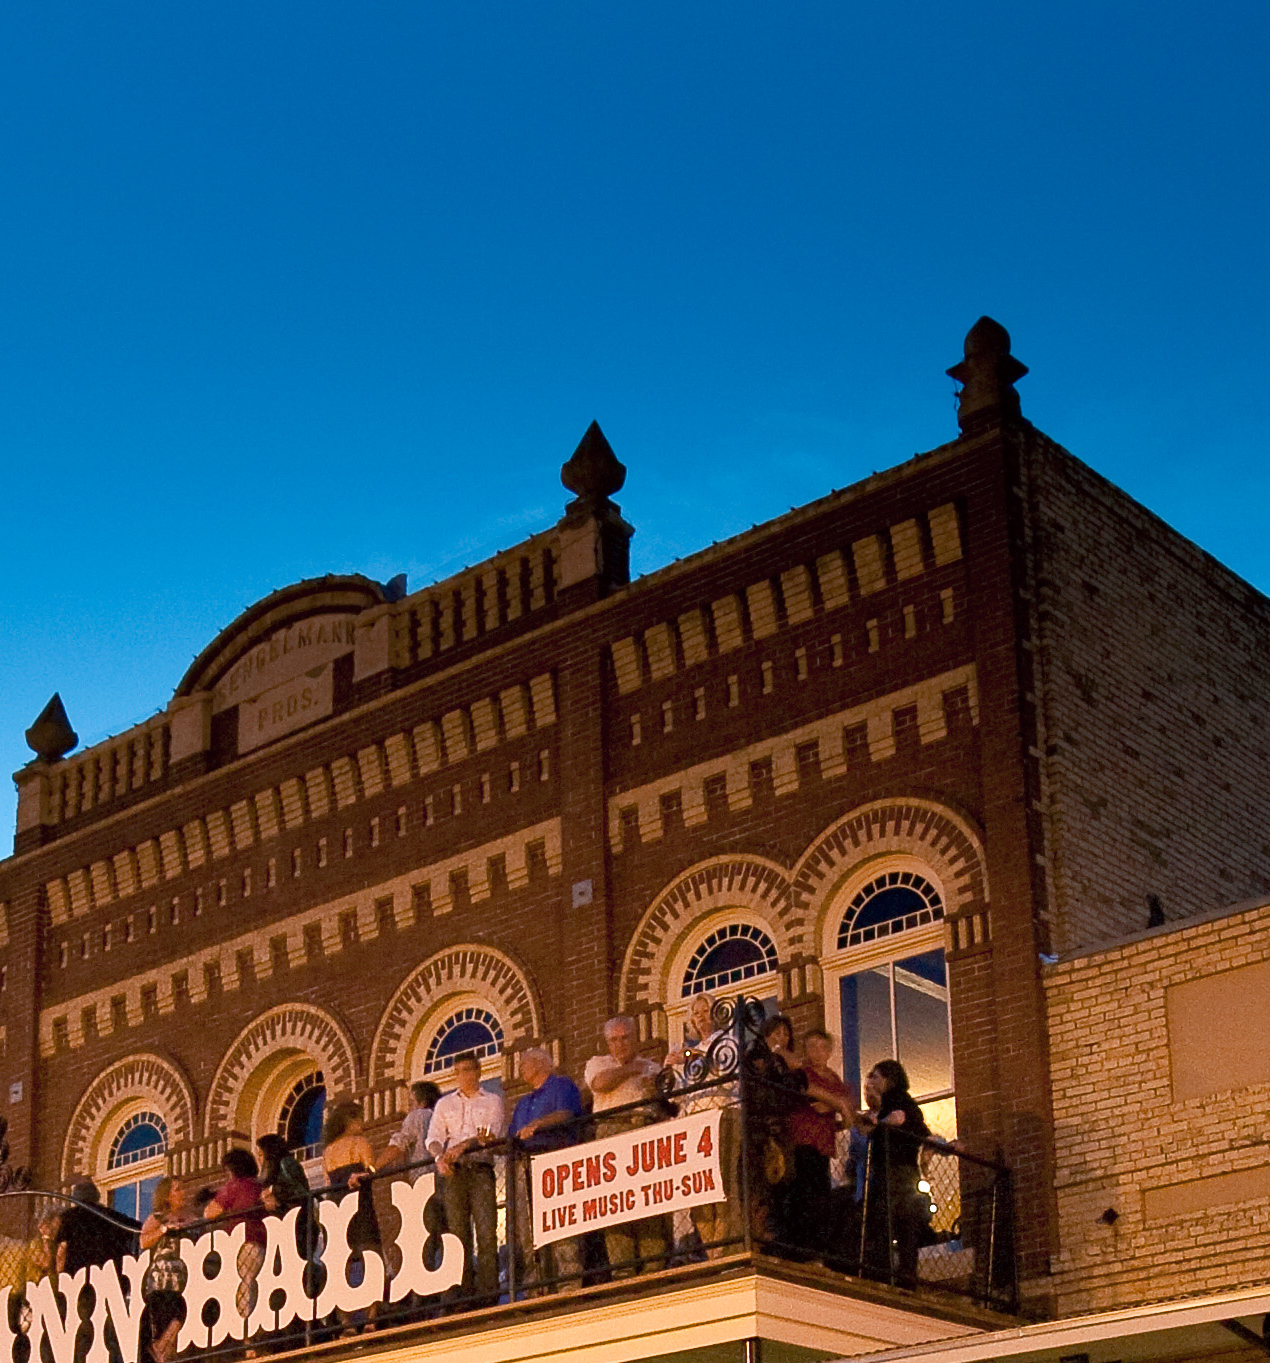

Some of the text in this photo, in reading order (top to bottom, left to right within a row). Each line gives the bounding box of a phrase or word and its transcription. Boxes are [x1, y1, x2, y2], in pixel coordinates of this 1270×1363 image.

[541, 1125, 713, 1198] OPENS JUNE 4
[542, 1168, 715, 1232] LIVE MUSIC THU-SUN
[177, 1172, 465, 1352] HALL
